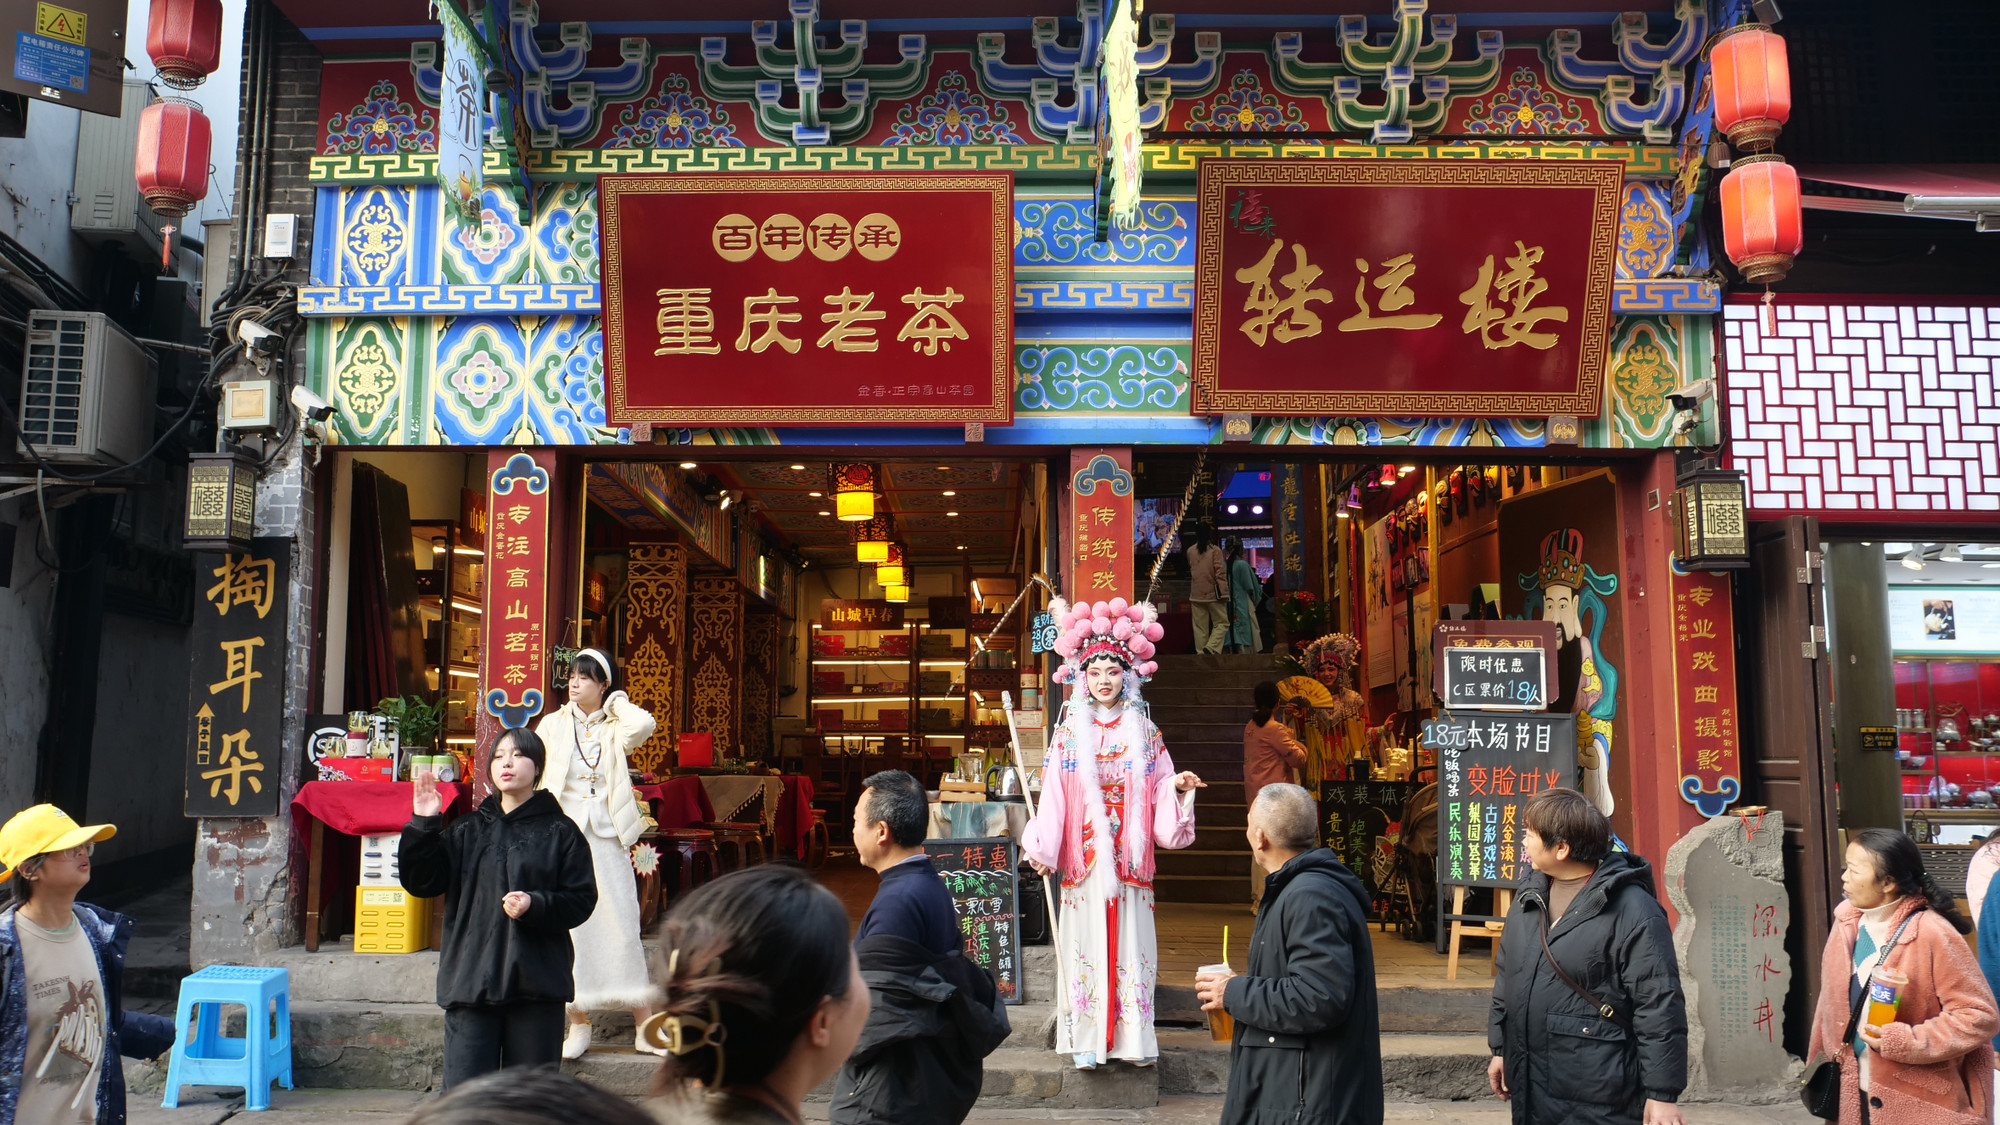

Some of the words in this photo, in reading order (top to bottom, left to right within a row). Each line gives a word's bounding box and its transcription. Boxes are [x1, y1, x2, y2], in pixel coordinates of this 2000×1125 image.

[714, 219, 900, 255] 百年传承
[653, 285, 970, 357] 重庆老茶
[1235, 237, 1569, 350] 转运楼
[1091, 506, 1118, 591] 传统戏
[503, 503, 532, 686] 专注高山茗茶
[831, 607, 894, 623] 山城早春
[201, 553, 276, 806] 掏耳朵
[1460, 655, 1525, 674] 限时优惠
[1688, 584, 1722, 772] 专业戏曲摄影
[1423, 724, 1467, 747] 18元
[1467, 720, 1551, 753] 本场节目
[1448, 802, 1464, 881] 民乐演奏
[1467, 801, 1482, 882] 梨园荟萃
[1483, 803, 1498, 881] 古彩戏法
[1500, 803, 1518, 881] 皮金滚灯
[993, 921, 1013, 981] 特色小罐茶
[1752, 903, 1782, 1043] 深水井
